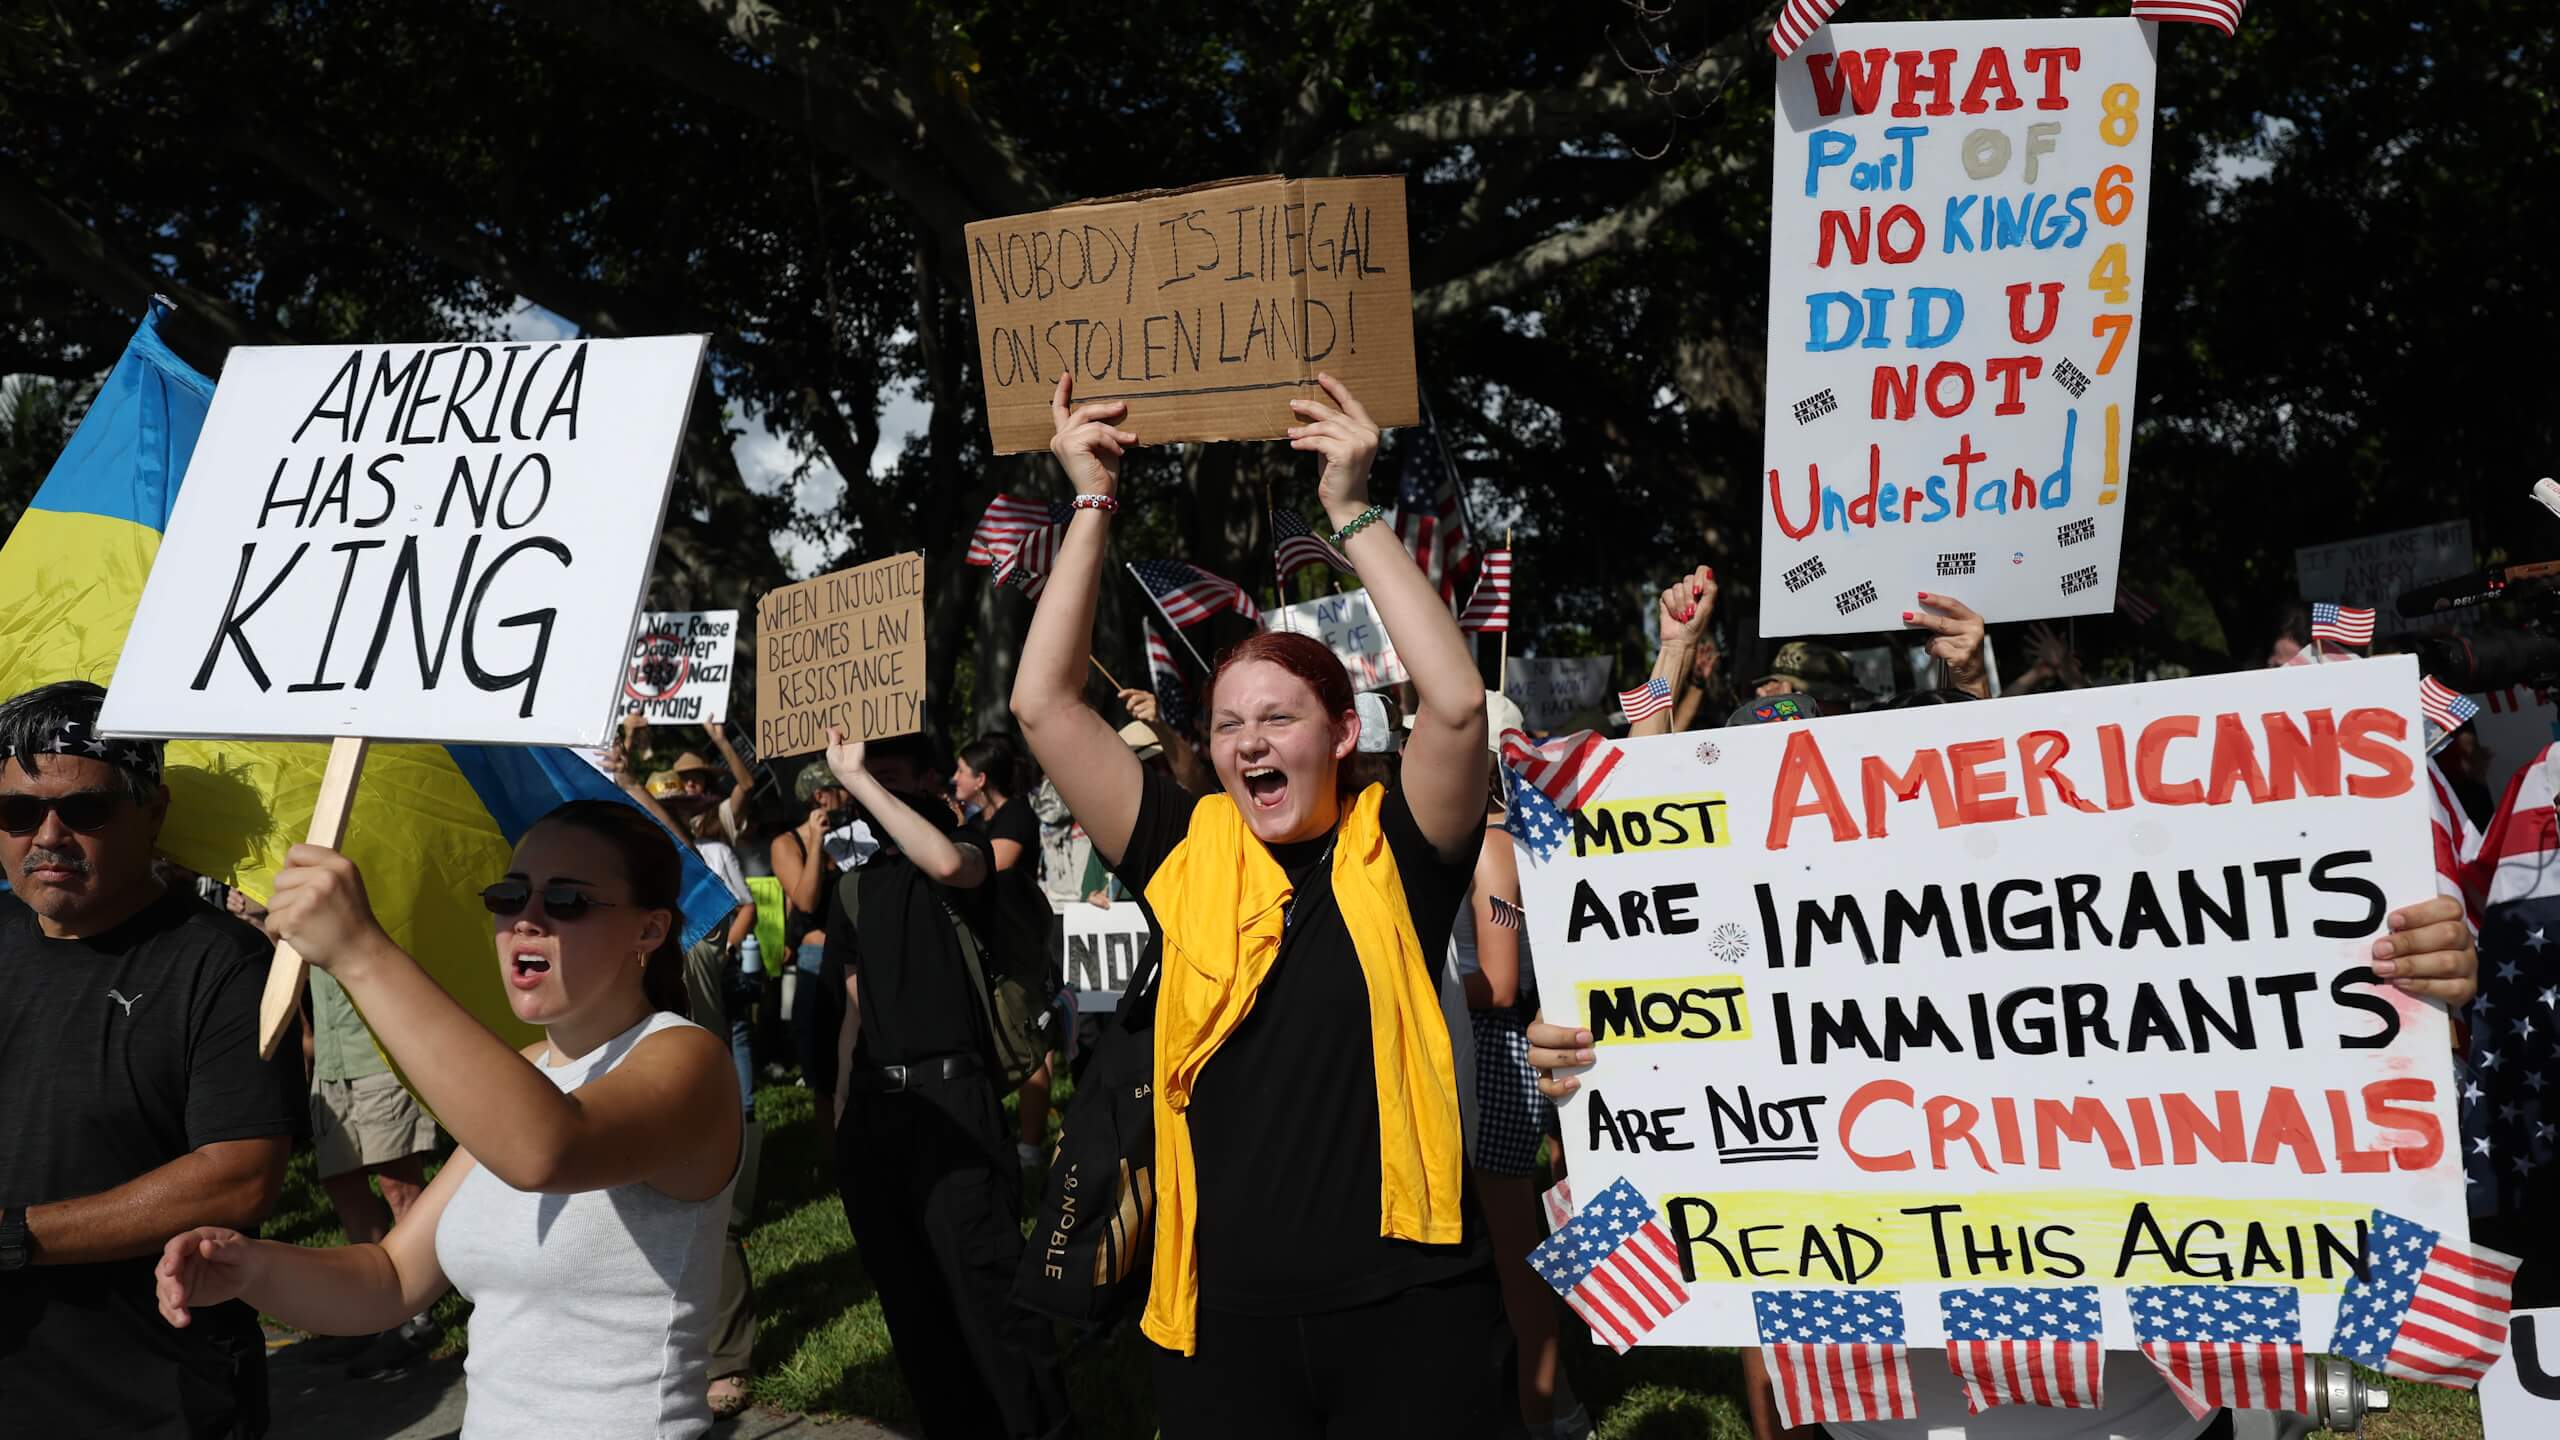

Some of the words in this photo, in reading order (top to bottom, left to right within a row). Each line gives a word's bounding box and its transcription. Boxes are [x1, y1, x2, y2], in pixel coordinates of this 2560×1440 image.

[1806, 47, 2080, 117] WHAT
[1962, 122, 2061, 185] OF
[975, 223, 1140, 305] NOBODY
[1158, 209, 1220, 290] IS
[1812, 204, 1925, 268] NO
[1943, 187, 2091, 253] KINGS
[1219, 290, 1356, 362] LAND!
[1806, 287, 1964, 352] DID
[2006, 282, 2064, 343] U
[292, 343, 588, 444] AMERICA
[1792, 388, 1831, 411] TRUMP
[1871, 356, 2042, 420] NOT
[2051, 369, 2082, 399] TRAITOR
[2062, 356, 2091, 385] TRUMP
[1798, 401, 1838, 426] TRAITOR
[257, 454, 405, 529] HAS
[434, 454, 552, 530] NO
[1766, 408, 2077, 541] Understand
[1938, 552, 1976, 561] TRUMP
[2057, 517, 2093, 534] TRUMP
[2058, 530, 2095, 548] TRAITOR
[762, 584, 818, 632] WHEN
[826, 558, 921, 614] INJUSTICE
[1781, 554, 1819, 580] TRUMP
[1788, 567, 1827, 593] TRAITOR
[1834, 580, 1872, 602] TRUMP
[1937, 566, 1975, 576] TRAITOR
[2060, 565, 2096, 583] TRUMP
[2062, 578, 2098, 596] TRAITOR
[2453, 589, 2502, 607] REURS
[191, 535, 573, 718] KING
[1317, 597, 1350, 627] AM
[1839, 593, 1878, 616] TRAITOR
[769, 622, 849, 672] BECOMES
[862, 609, 910, 651] LAW
[1347, 624, 1369, 652] OF
[619, 696, 702, 720] ermany
[778, 651, 904, 710] RESISTANCE
[762, 704, 851, 759] BECOMES
[863, 689, 918, 738] DUTY
[1572, 800, 1727, 857] MOST
[1766, 707, 2414, 850] AMERICANS
[1567, 879, 1700, 943] ARE
[1755, 849, 2387, 968] IMMIGRANTS
[1589, 986, 1745, 1043] MOST
[1771, 965, 2401, 1065] IMMIGRANTS
[1589, 1089, 1695, 1153] ARE
[1706, 1085, 1828, 1152] NOT
[1838, 1077, 2445, 1174] CRIMINALS
[1045, 1195, 1076, 1280] NOBLE
[1667, 1196, 1885, 1285] READ
[1900, 1203, 2085, 1279] THIS
[2113, 1201, 2373, 1283] AGAIN
